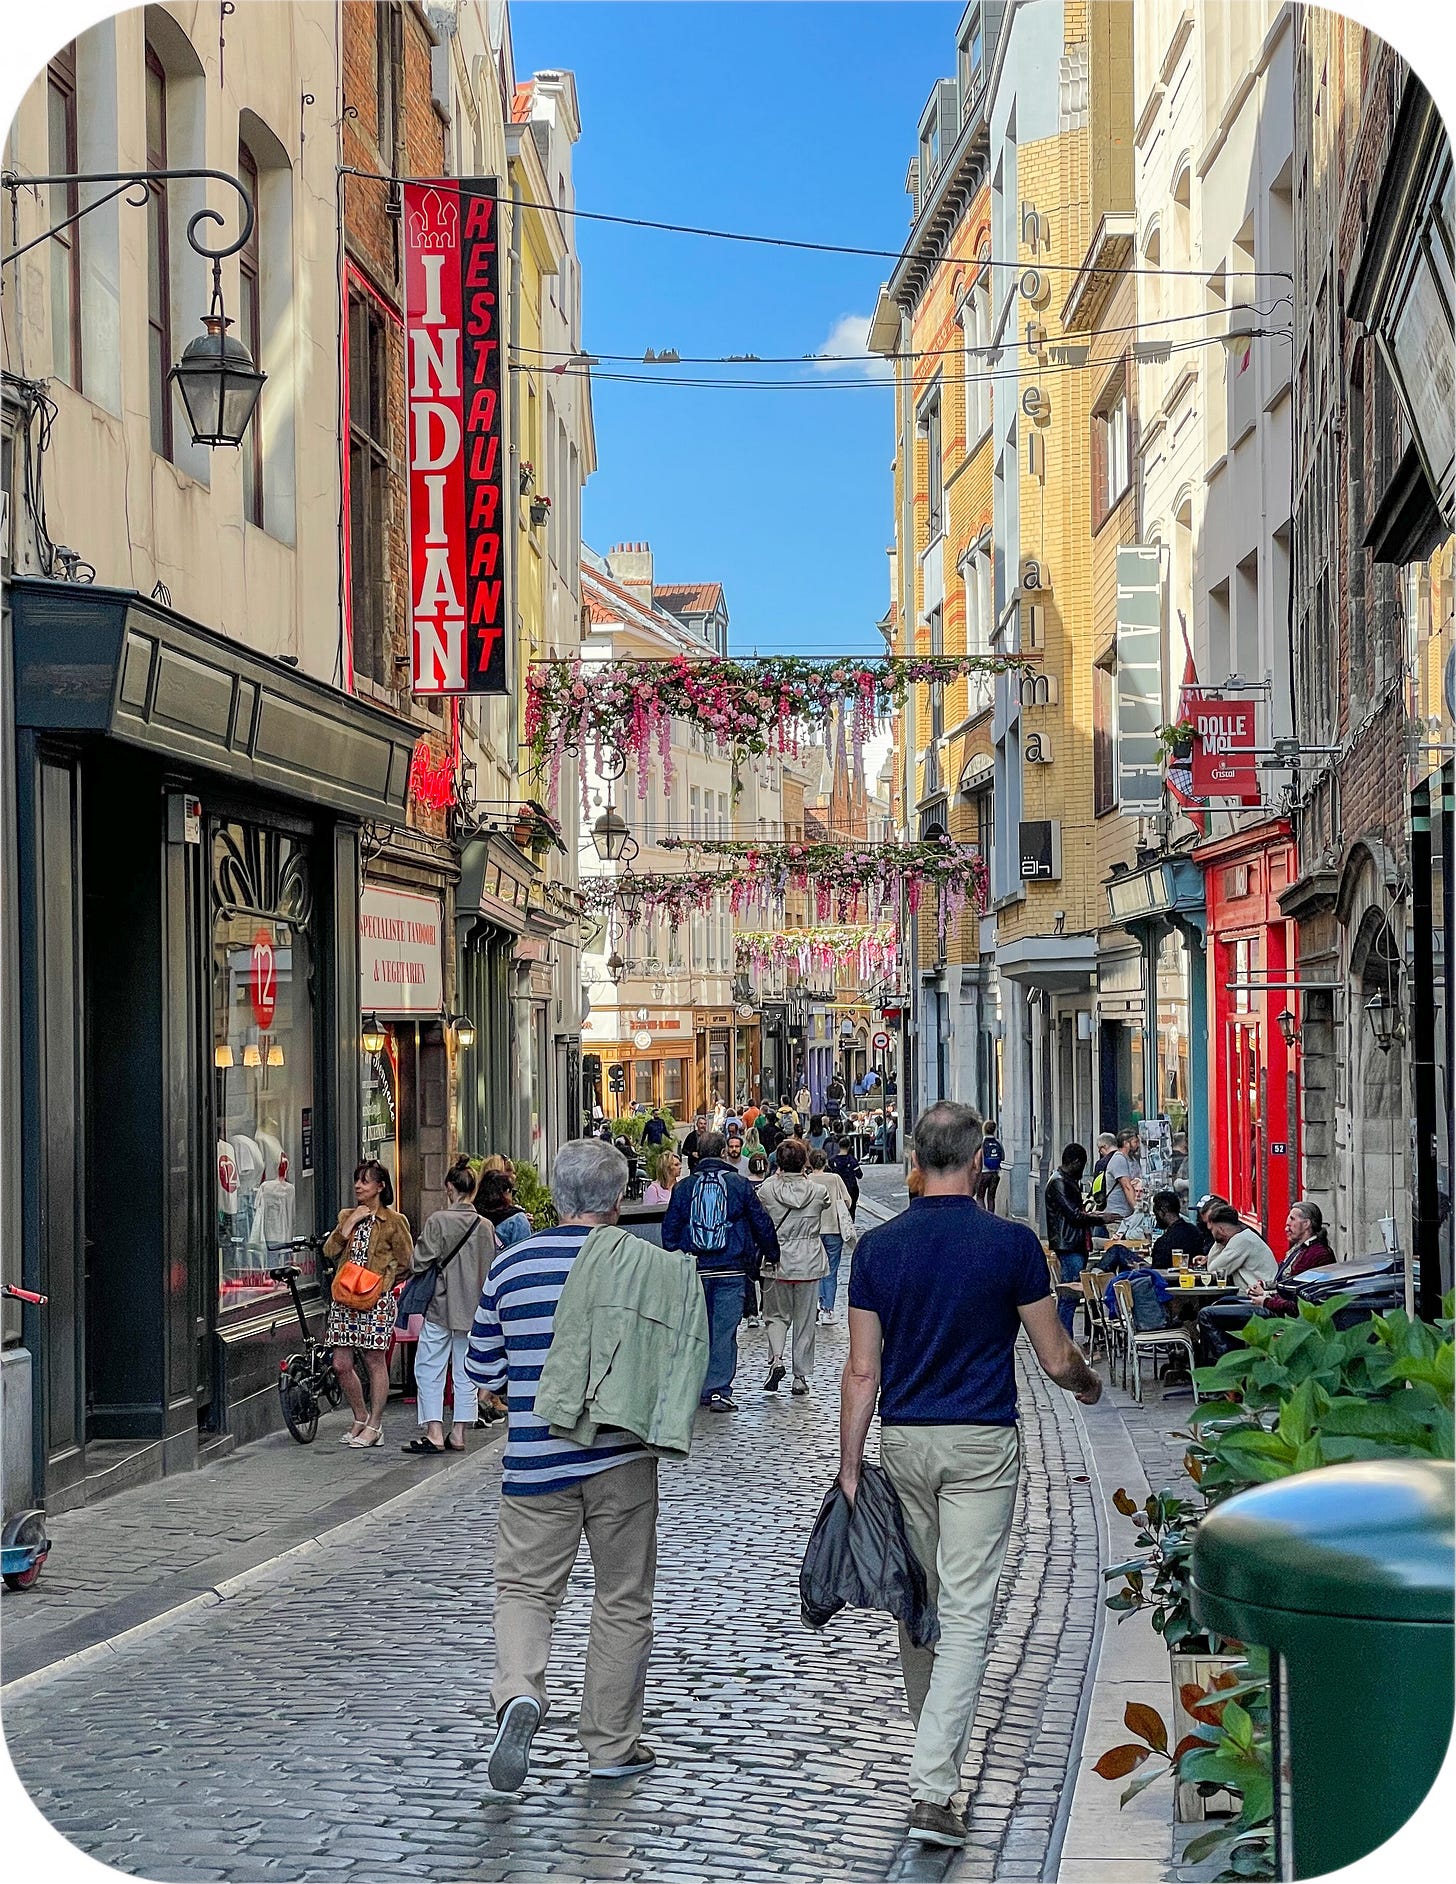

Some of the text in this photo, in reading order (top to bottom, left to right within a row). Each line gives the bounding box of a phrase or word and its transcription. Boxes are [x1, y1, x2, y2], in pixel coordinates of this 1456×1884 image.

[1020, 200, 1049, 476] hotel
[409, 254, 467, 690] INDIAN
[464, 197, 503, 673] RESTAURANT
[1020, 559, 1054, 764] alma
[1116, 544, 1163, 815] PLAIZIER
[1197, 715, 1247, 736] DOLLE
[1211, 768, 1236, 778] Cristal
[373, 959, 426, 984] & VEGETARIEN
[407, 921, 436, 946] TANDOORI
[1274, 1144, 1284, 1153] 52
